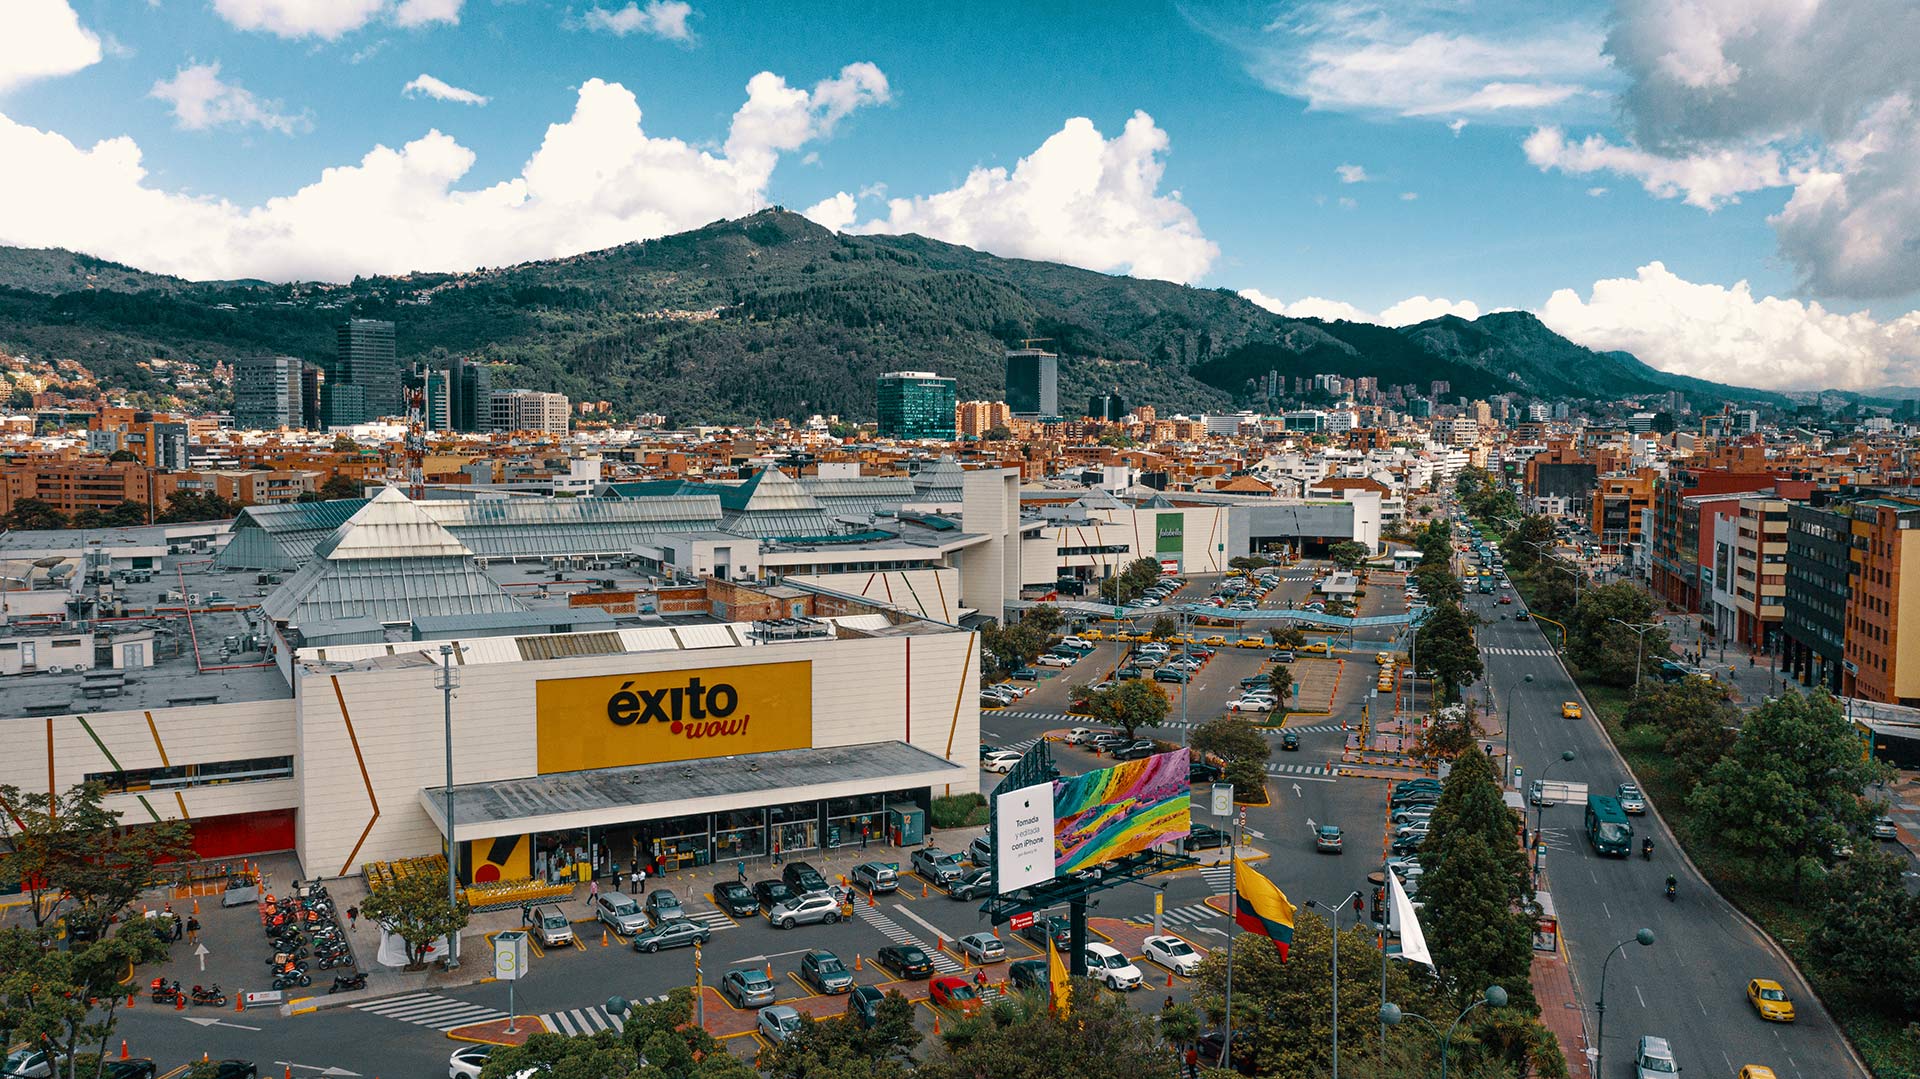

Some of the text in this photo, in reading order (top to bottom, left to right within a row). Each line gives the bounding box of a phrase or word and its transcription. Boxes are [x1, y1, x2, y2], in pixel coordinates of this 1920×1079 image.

[607, 677, 738, 734] éxito
[684, 714, 750, 739] wow!
[1215, 795, 1227, 811] 3
[1015, 816, 1039, 828] Tomada
[1019, 826, 1040, 838] editada
[1011, 836, 1044, 851] con iPhone
[497, 950, 515, 972] 3
